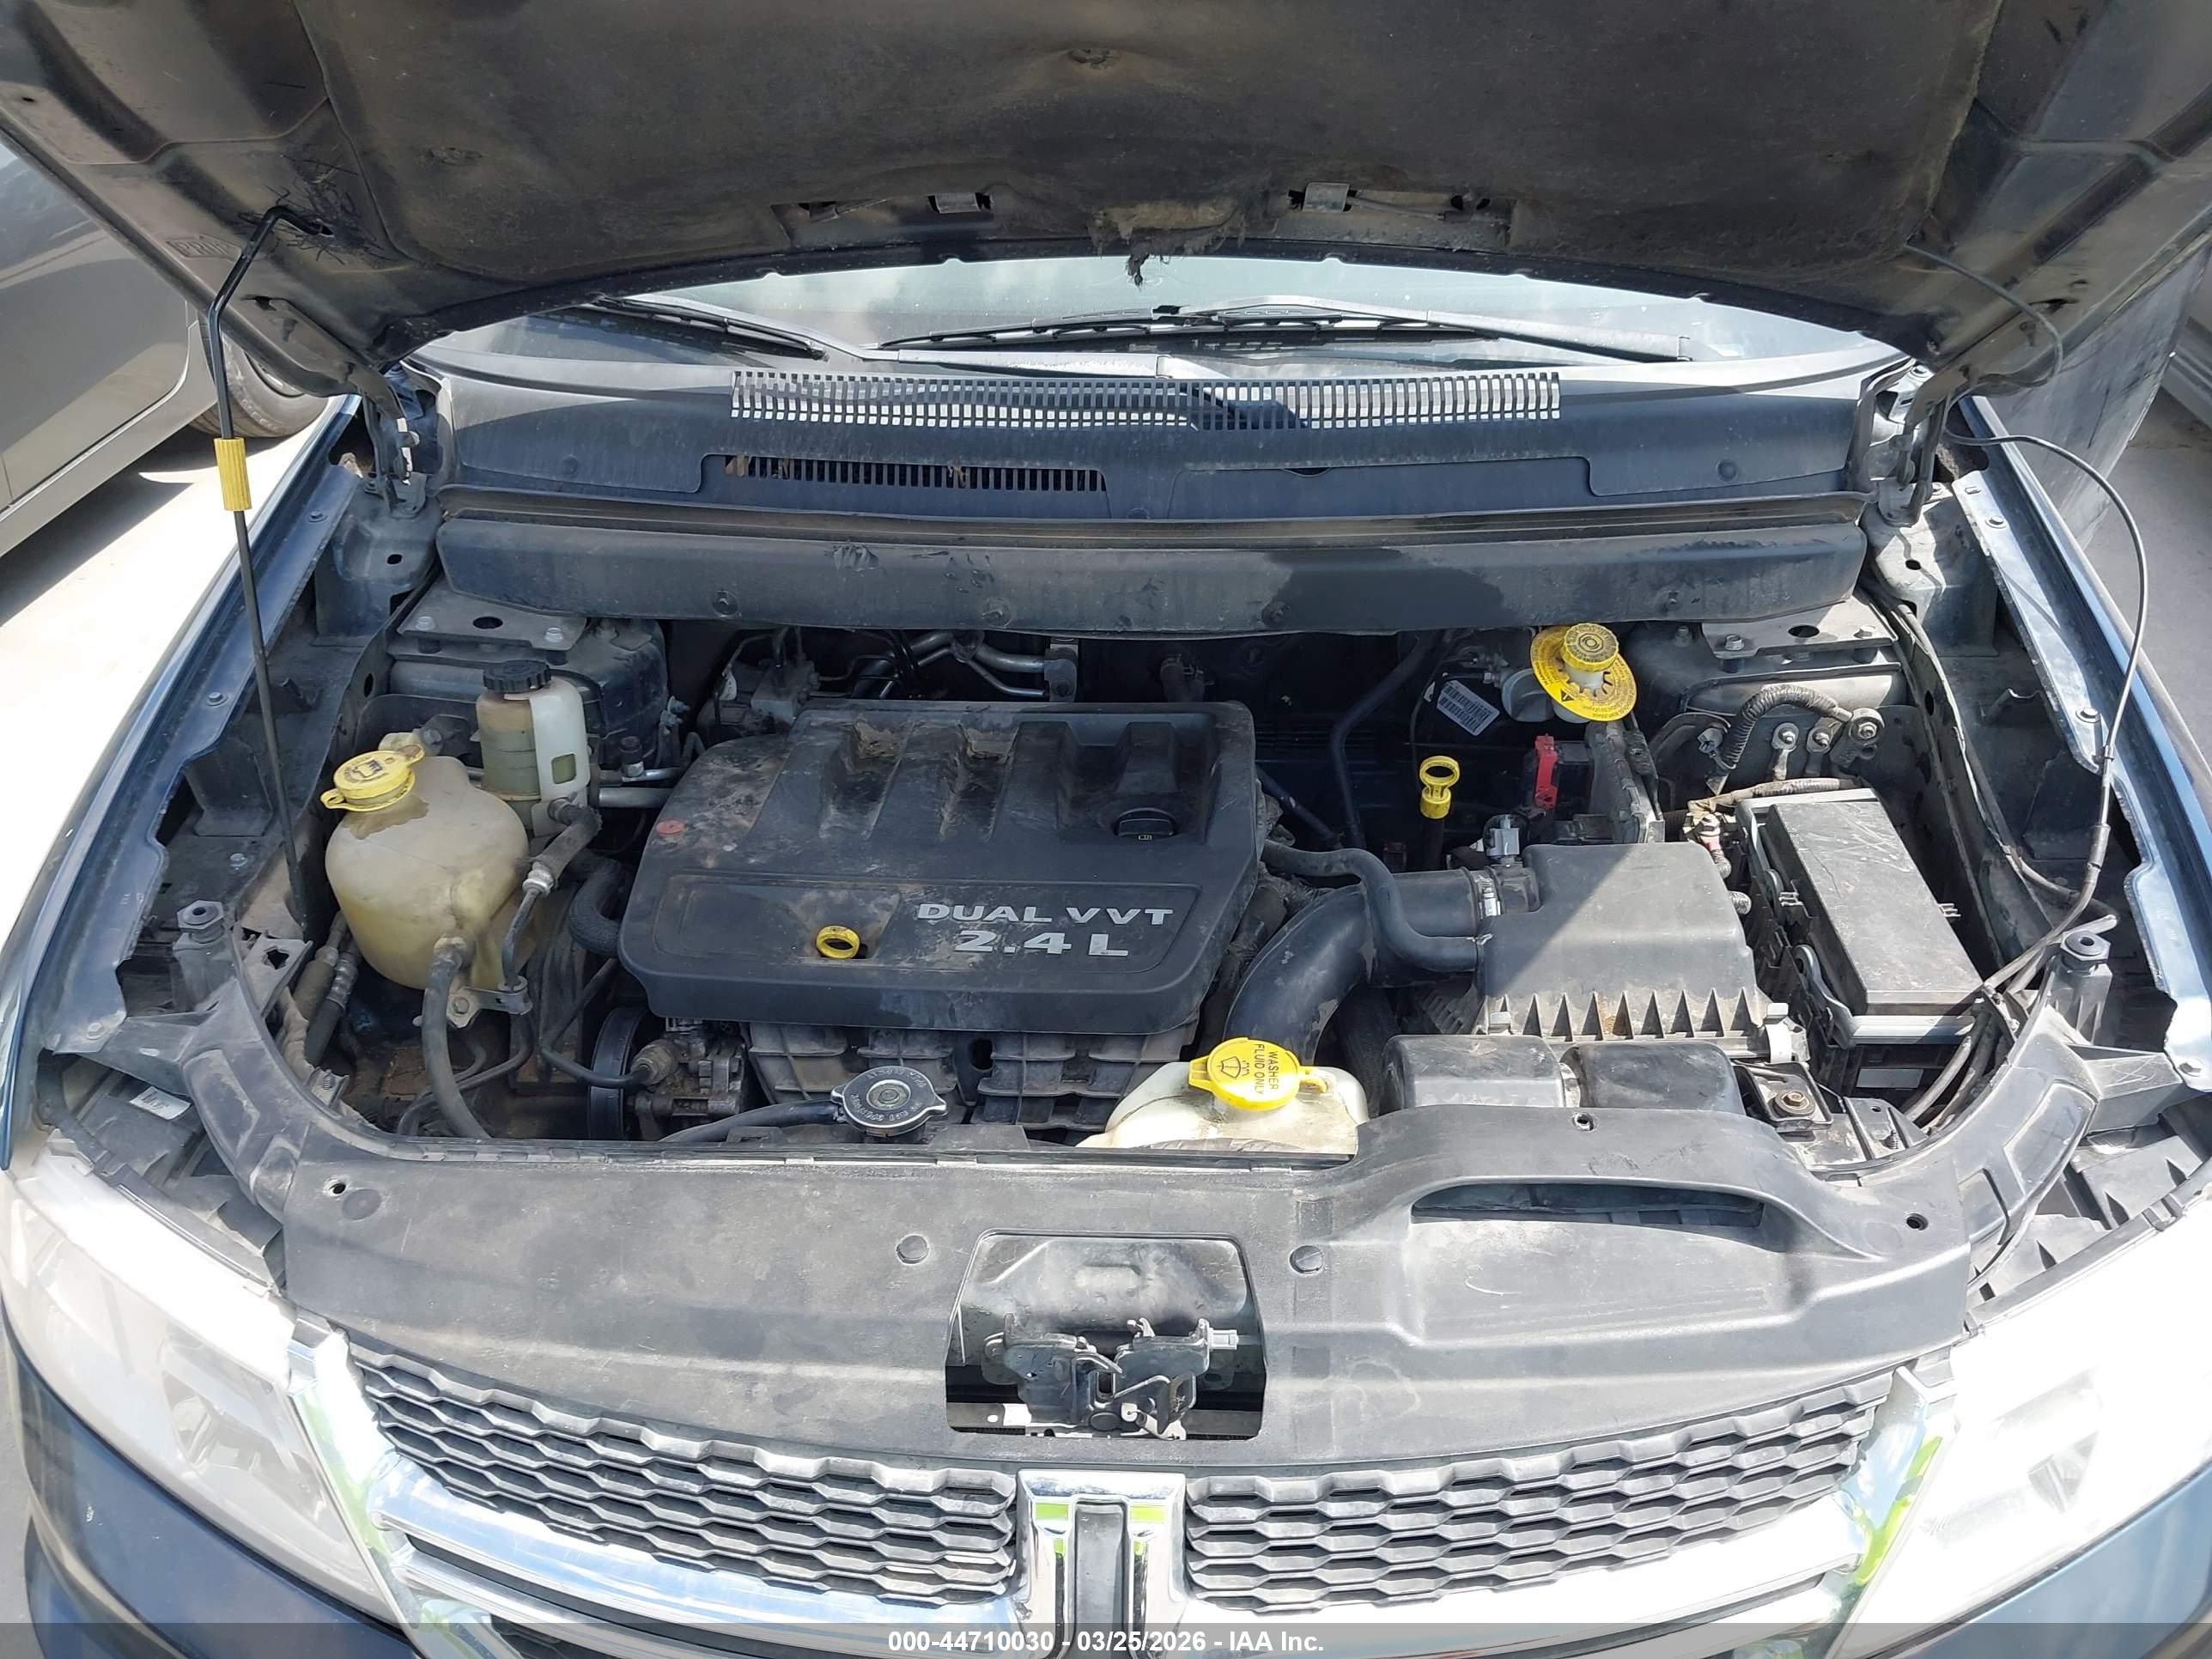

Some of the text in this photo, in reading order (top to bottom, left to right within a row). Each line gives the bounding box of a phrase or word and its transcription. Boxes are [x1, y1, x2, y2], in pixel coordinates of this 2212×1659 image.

[917, 903, 1174, 925] DUAL VVT
[954, 929, 1129, 957] 2.4 L
[1255, 1043, 1265, 1095] FLUID ONLY
[1267, 1051, 1279, 1090] WASHER
